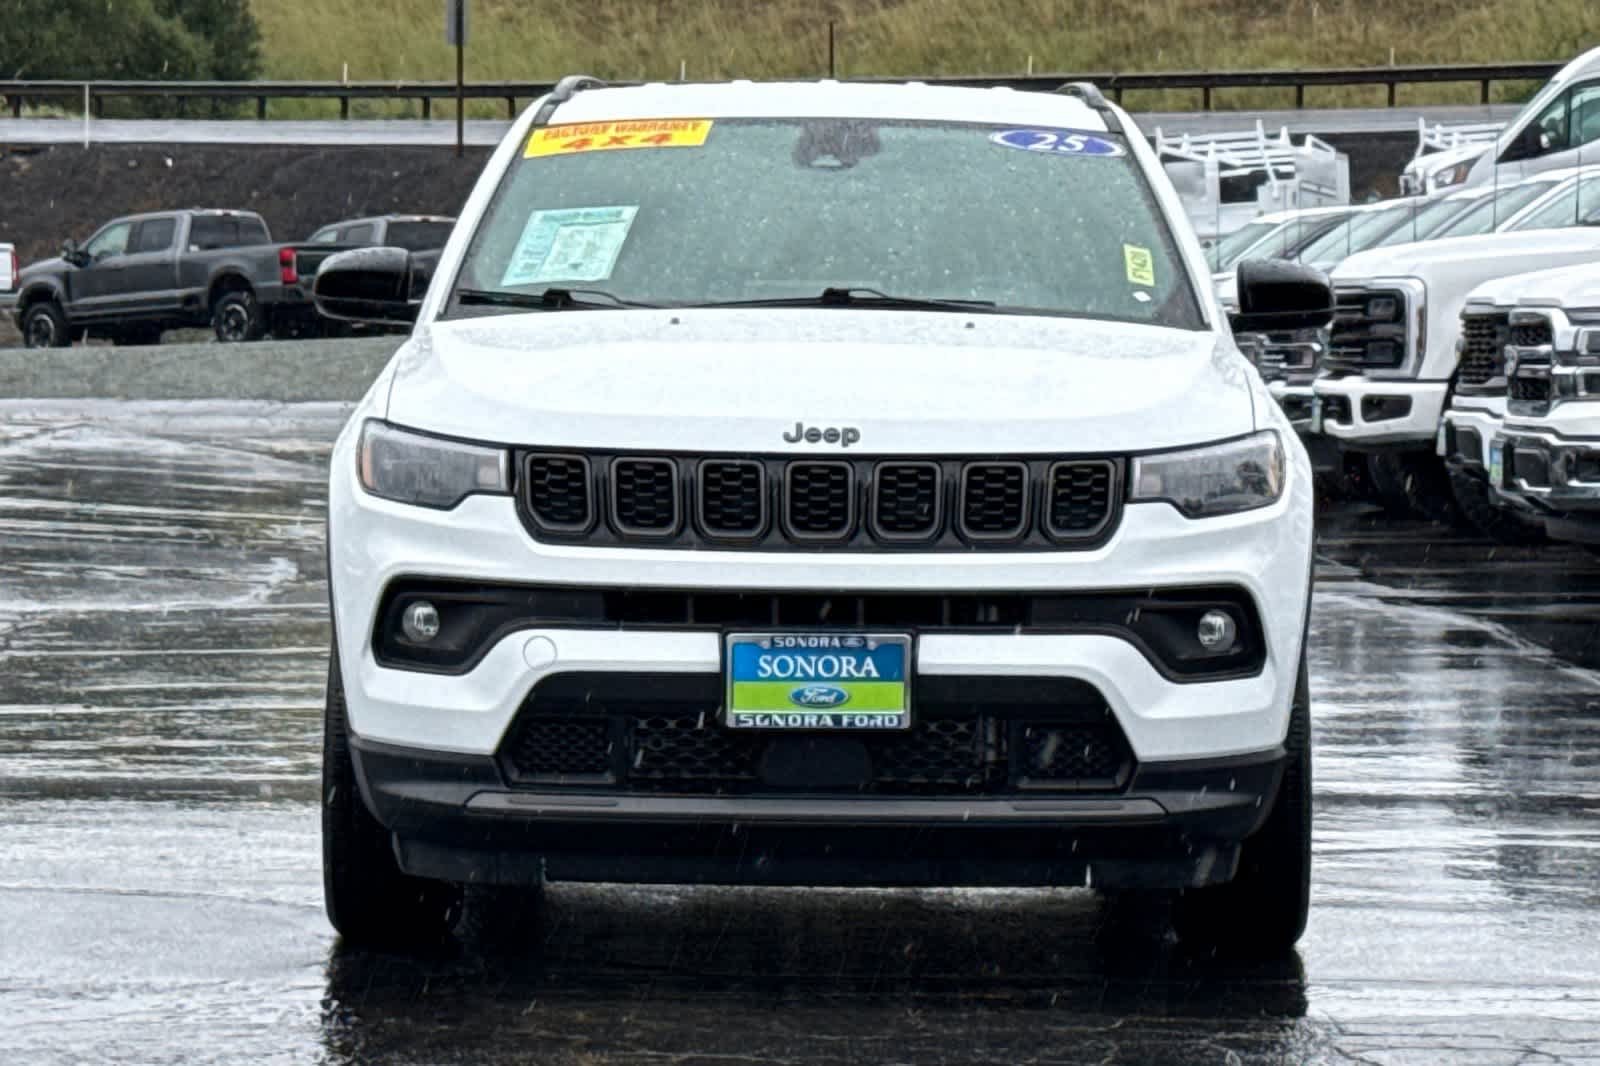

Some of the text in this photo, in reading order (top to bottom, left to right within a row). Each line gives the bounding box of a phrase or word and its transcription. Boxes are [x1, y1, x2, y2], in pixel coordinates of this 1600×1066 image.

[1028, 133, 1088, 151] 25
[782, 422, 861, 448] Jeep
[773, 636, 841, 648] SONORA
[757, 655, 880, 678] SONORA
[801, 687, 838, 704] Ford
[738, 714, 899, 728] SONORA FORD
